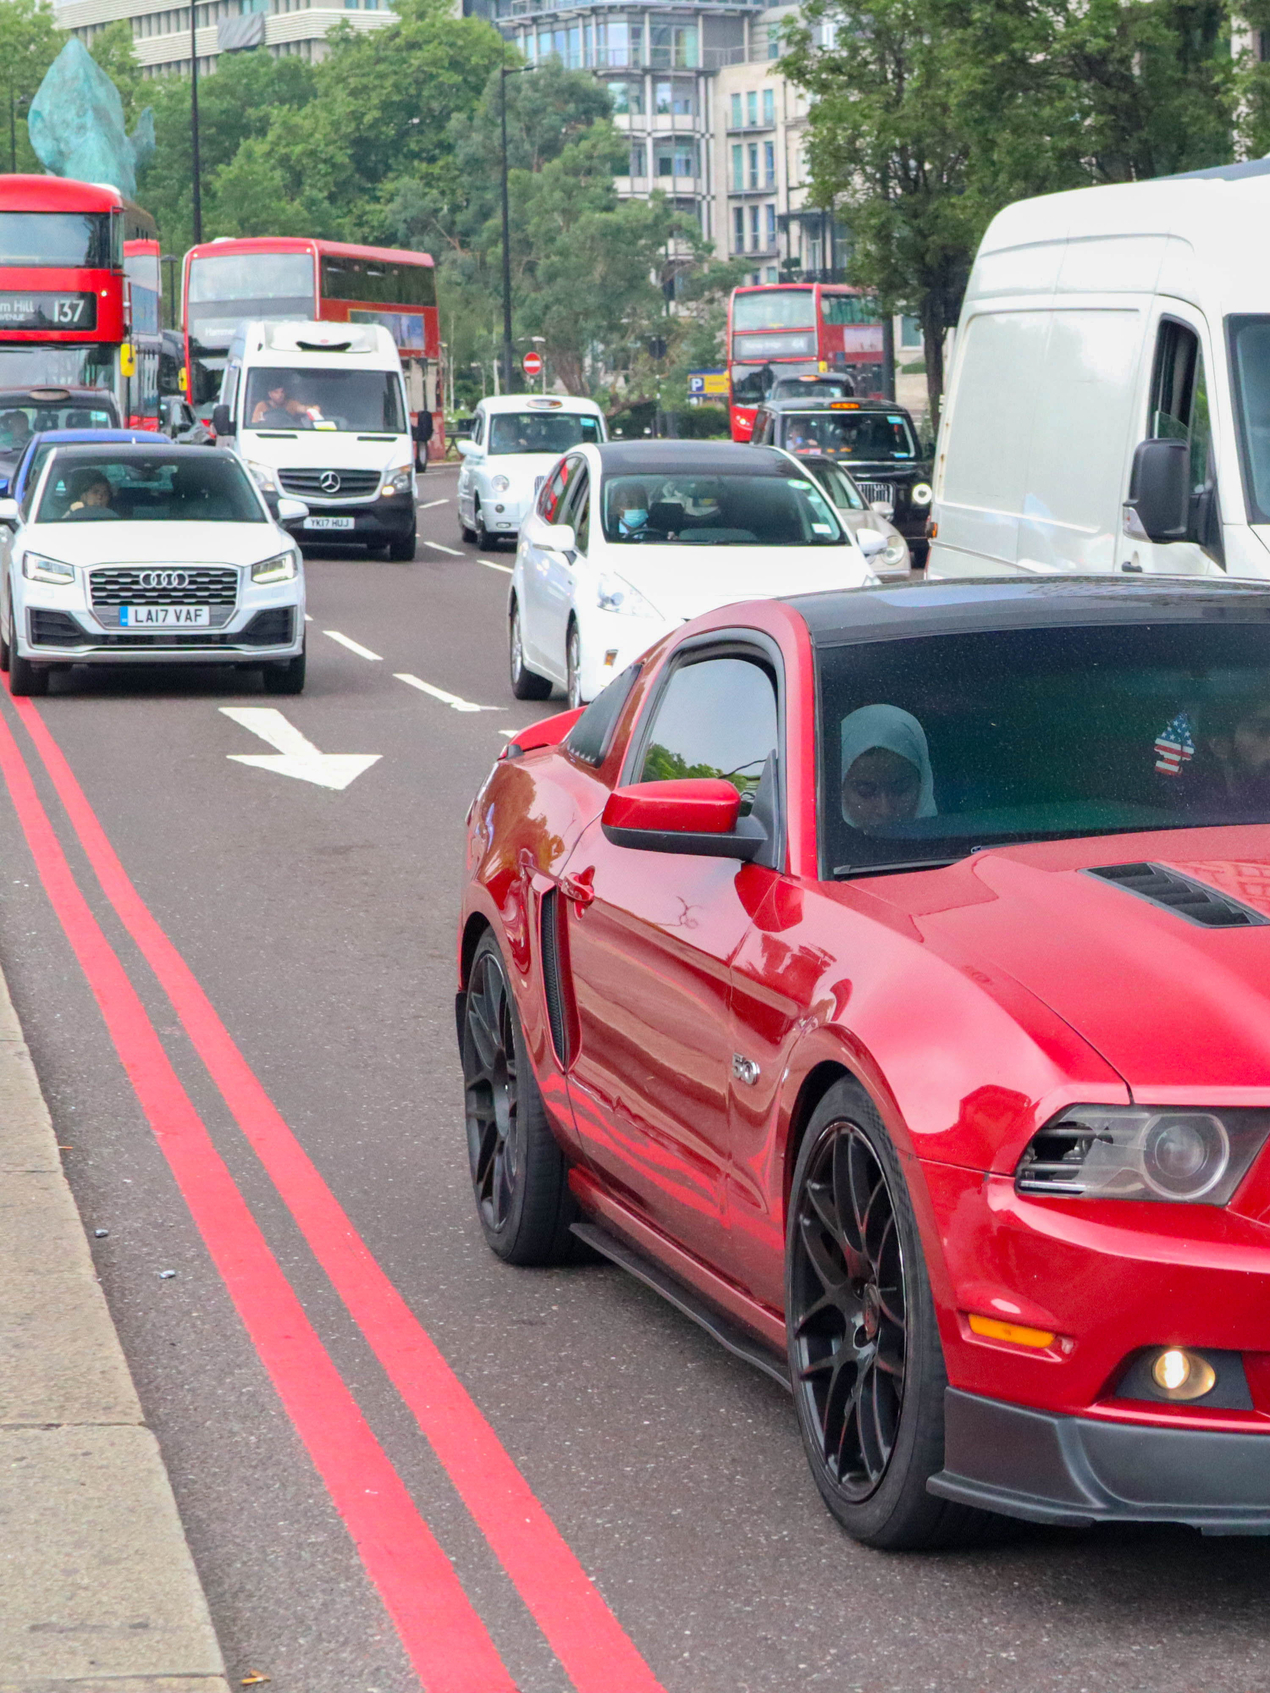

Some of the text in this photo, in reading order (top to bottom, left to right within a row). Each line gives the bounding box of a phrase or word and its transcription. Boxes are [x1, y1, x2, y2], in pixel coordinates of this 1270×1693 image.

[0, 300, 34, 312] m Hill
[54, 300, 84, 322] 137
[0, 313, 25, 321] VENUE
[691, 378, 703, 392] P
[134, 609, 204, 623] LA17 VAF
